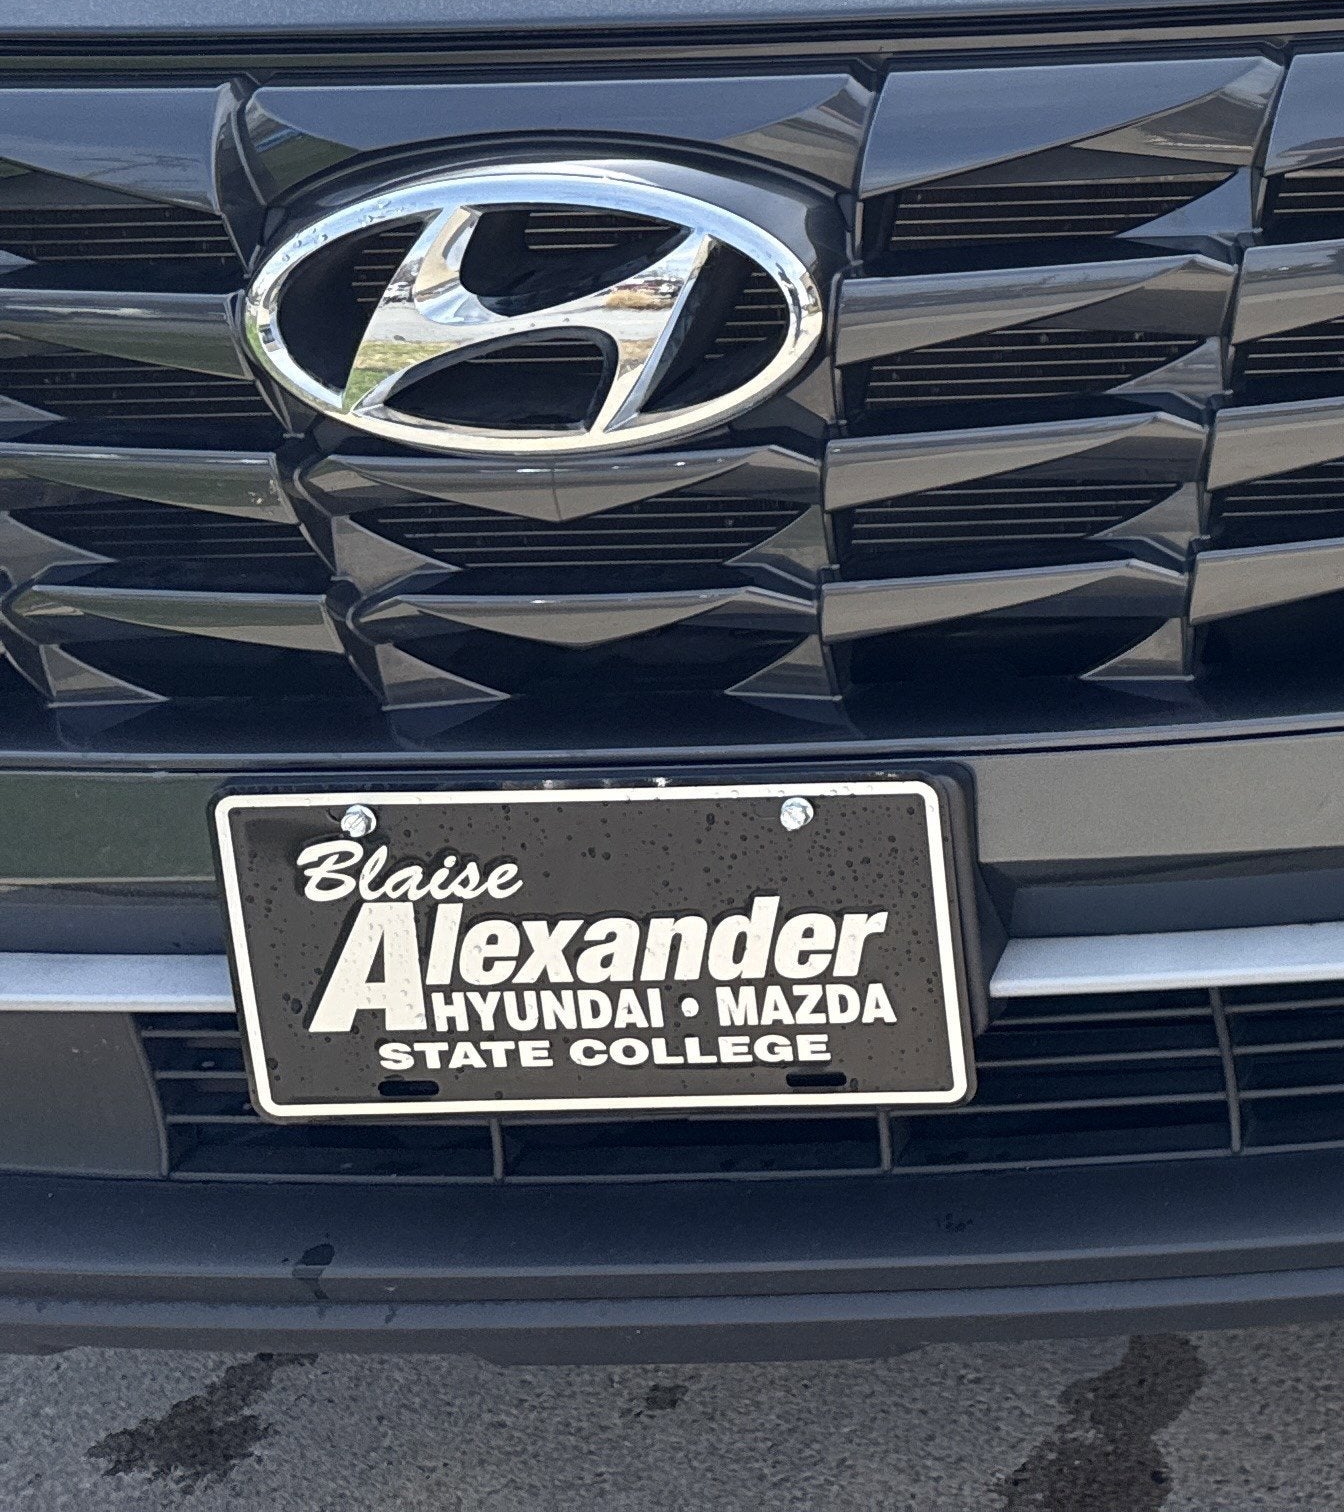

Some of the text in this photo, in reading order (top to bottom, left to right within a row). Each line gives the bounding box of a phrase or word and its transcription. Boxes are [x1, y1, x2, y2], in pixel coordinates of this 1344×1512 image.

[296, 840, 523, 904] Blaise
[309, 896, 888, 1034] Alexander
[433, 983, 898, 1033] HYUNDAI MAZDA
[379, 1034, 832, 1071] STATE COLLEGE
